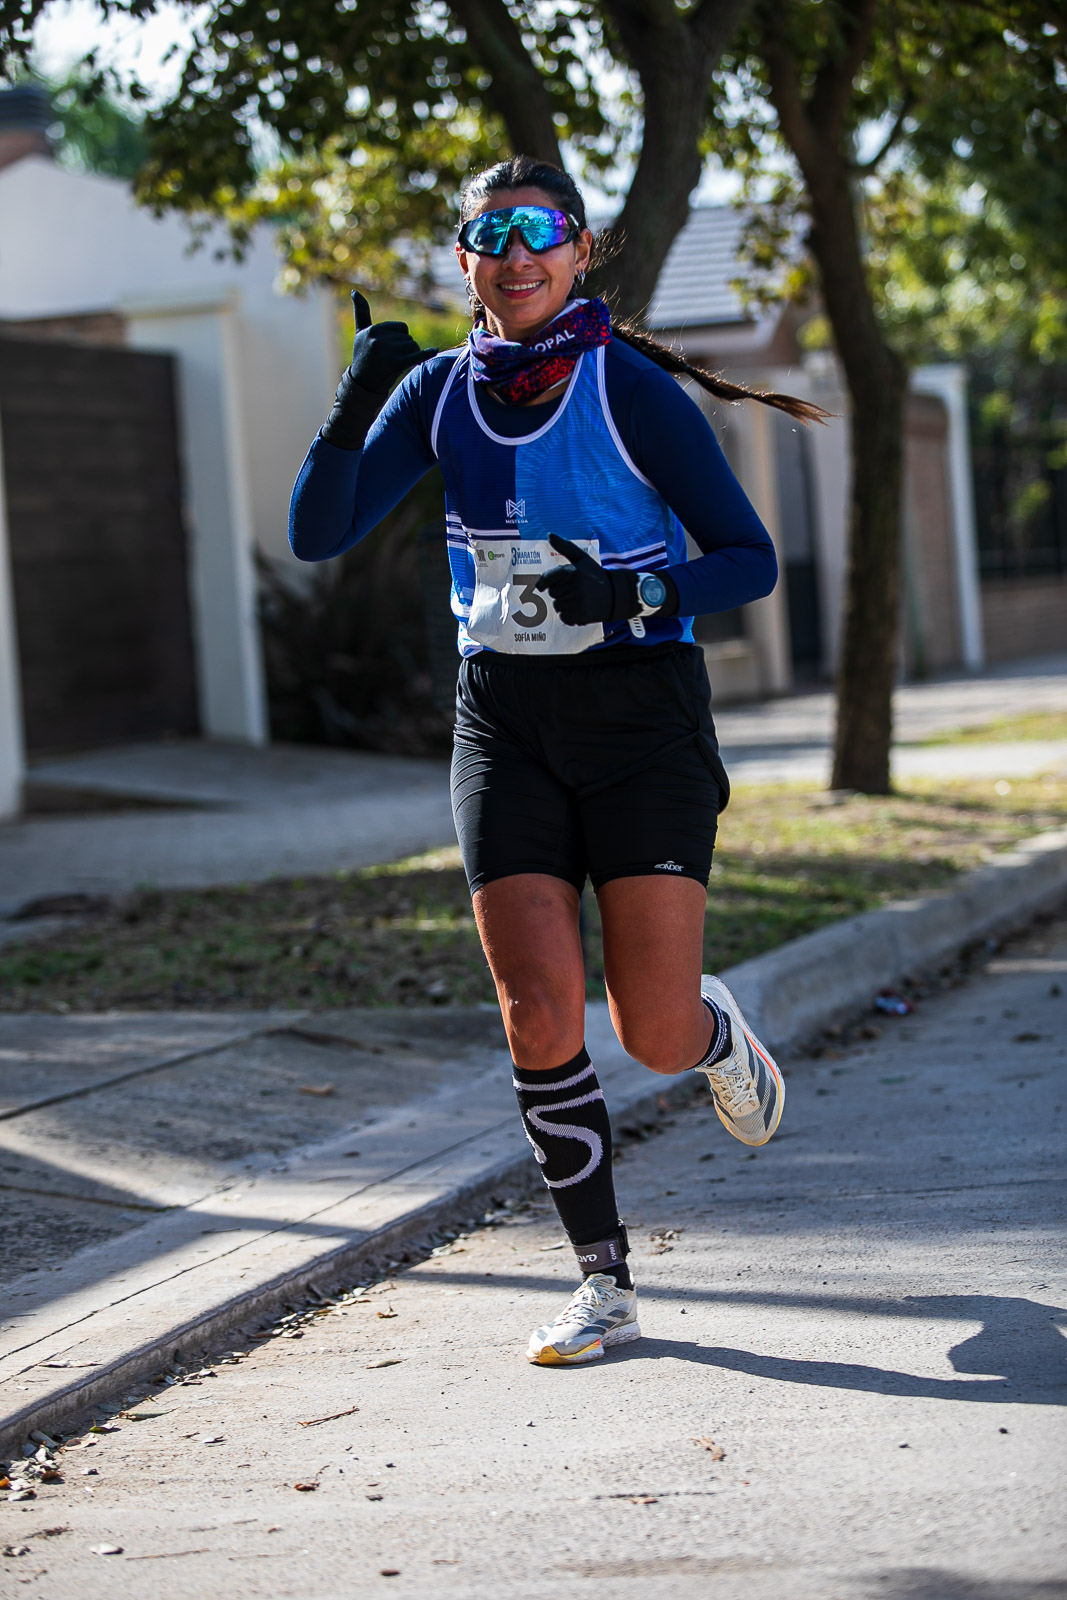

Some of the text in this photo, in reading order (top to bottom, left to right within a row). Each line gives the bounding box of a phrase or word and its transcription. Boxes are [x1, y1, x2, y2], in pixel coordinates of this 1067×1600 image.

[529, 329, 576, 353] OPAL
[517, 550, 541, 560] MARATÓN
[514, 631, 547, 642] SOFÍA MIÑO
